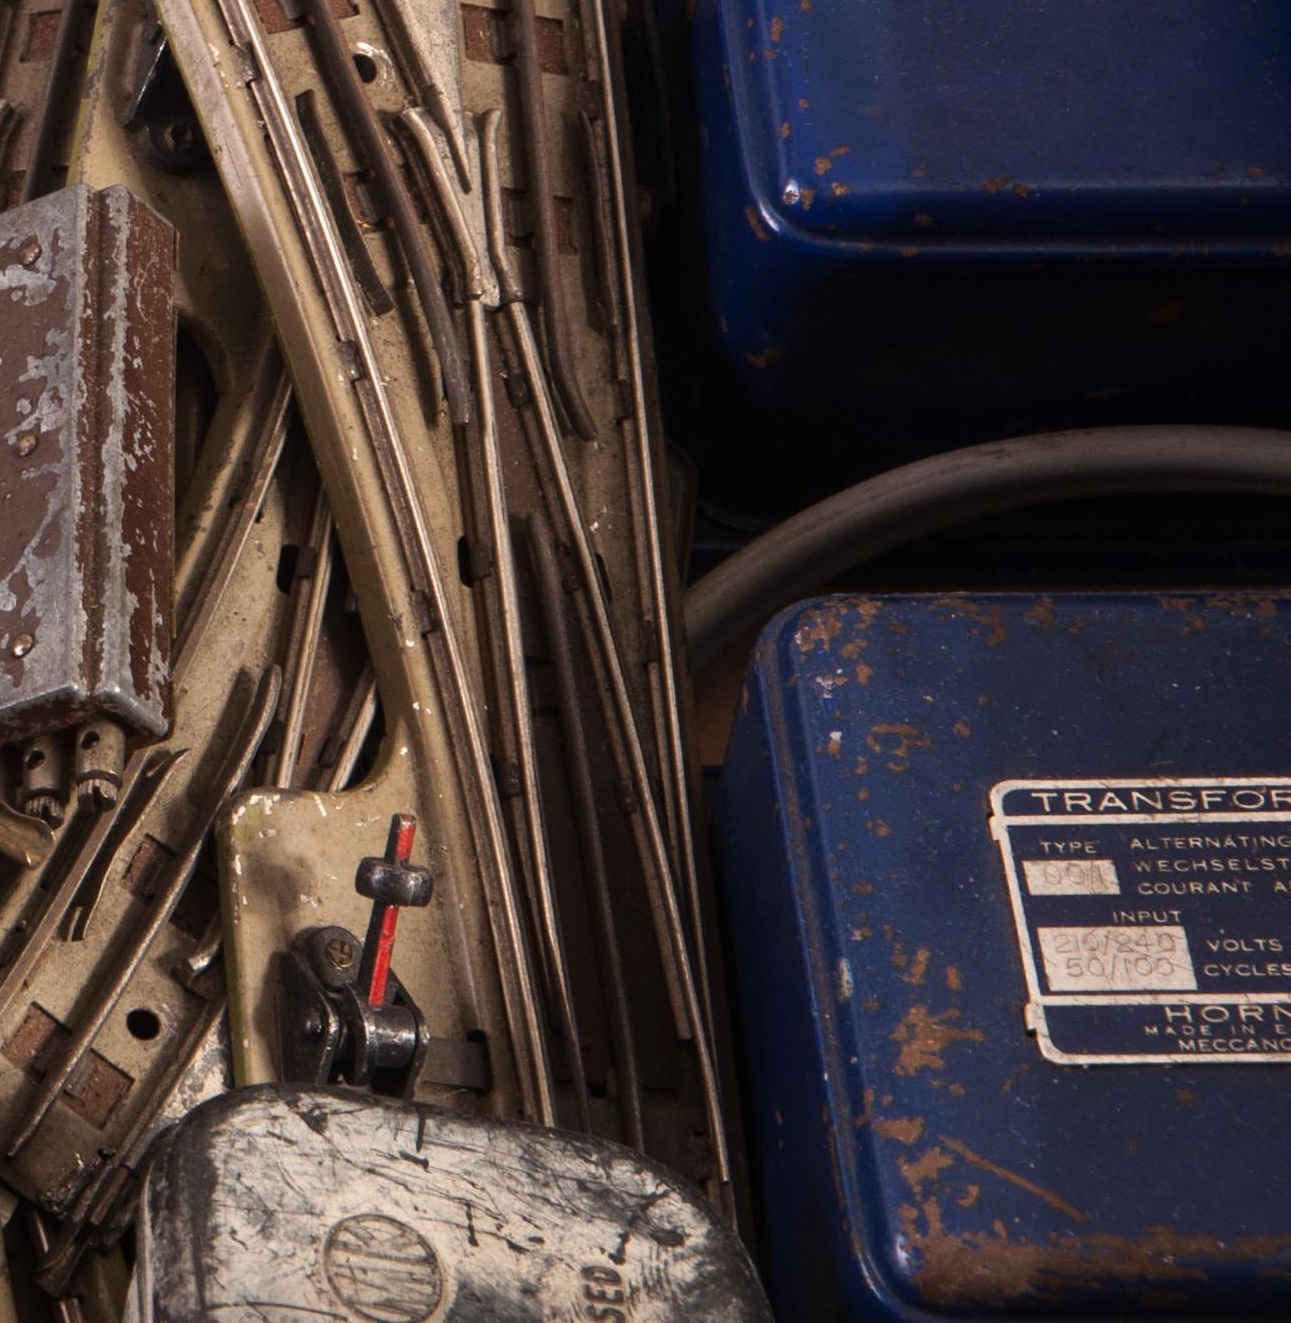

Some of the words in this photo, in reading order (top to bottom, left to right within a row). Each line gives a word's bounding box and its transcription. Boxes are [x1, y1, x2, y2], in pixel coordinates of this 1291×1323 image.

[1040, 841, 1098, 854] TYPE
[1130, 835, 1291, 850] ALTERNATING
[1131, 858, 1290, 873] WECHSELST
[1137, 881, 1252, 895] COURANT
[1112, 910, 1182, 923] INPUT
[1206, 939, 1283, 952] VOLTS
[1203, 963, 1291, 977] CYCLES
[1144, 1024, 1212, 1036] MADE
[1230, 1024, 1256, 1035] IN
